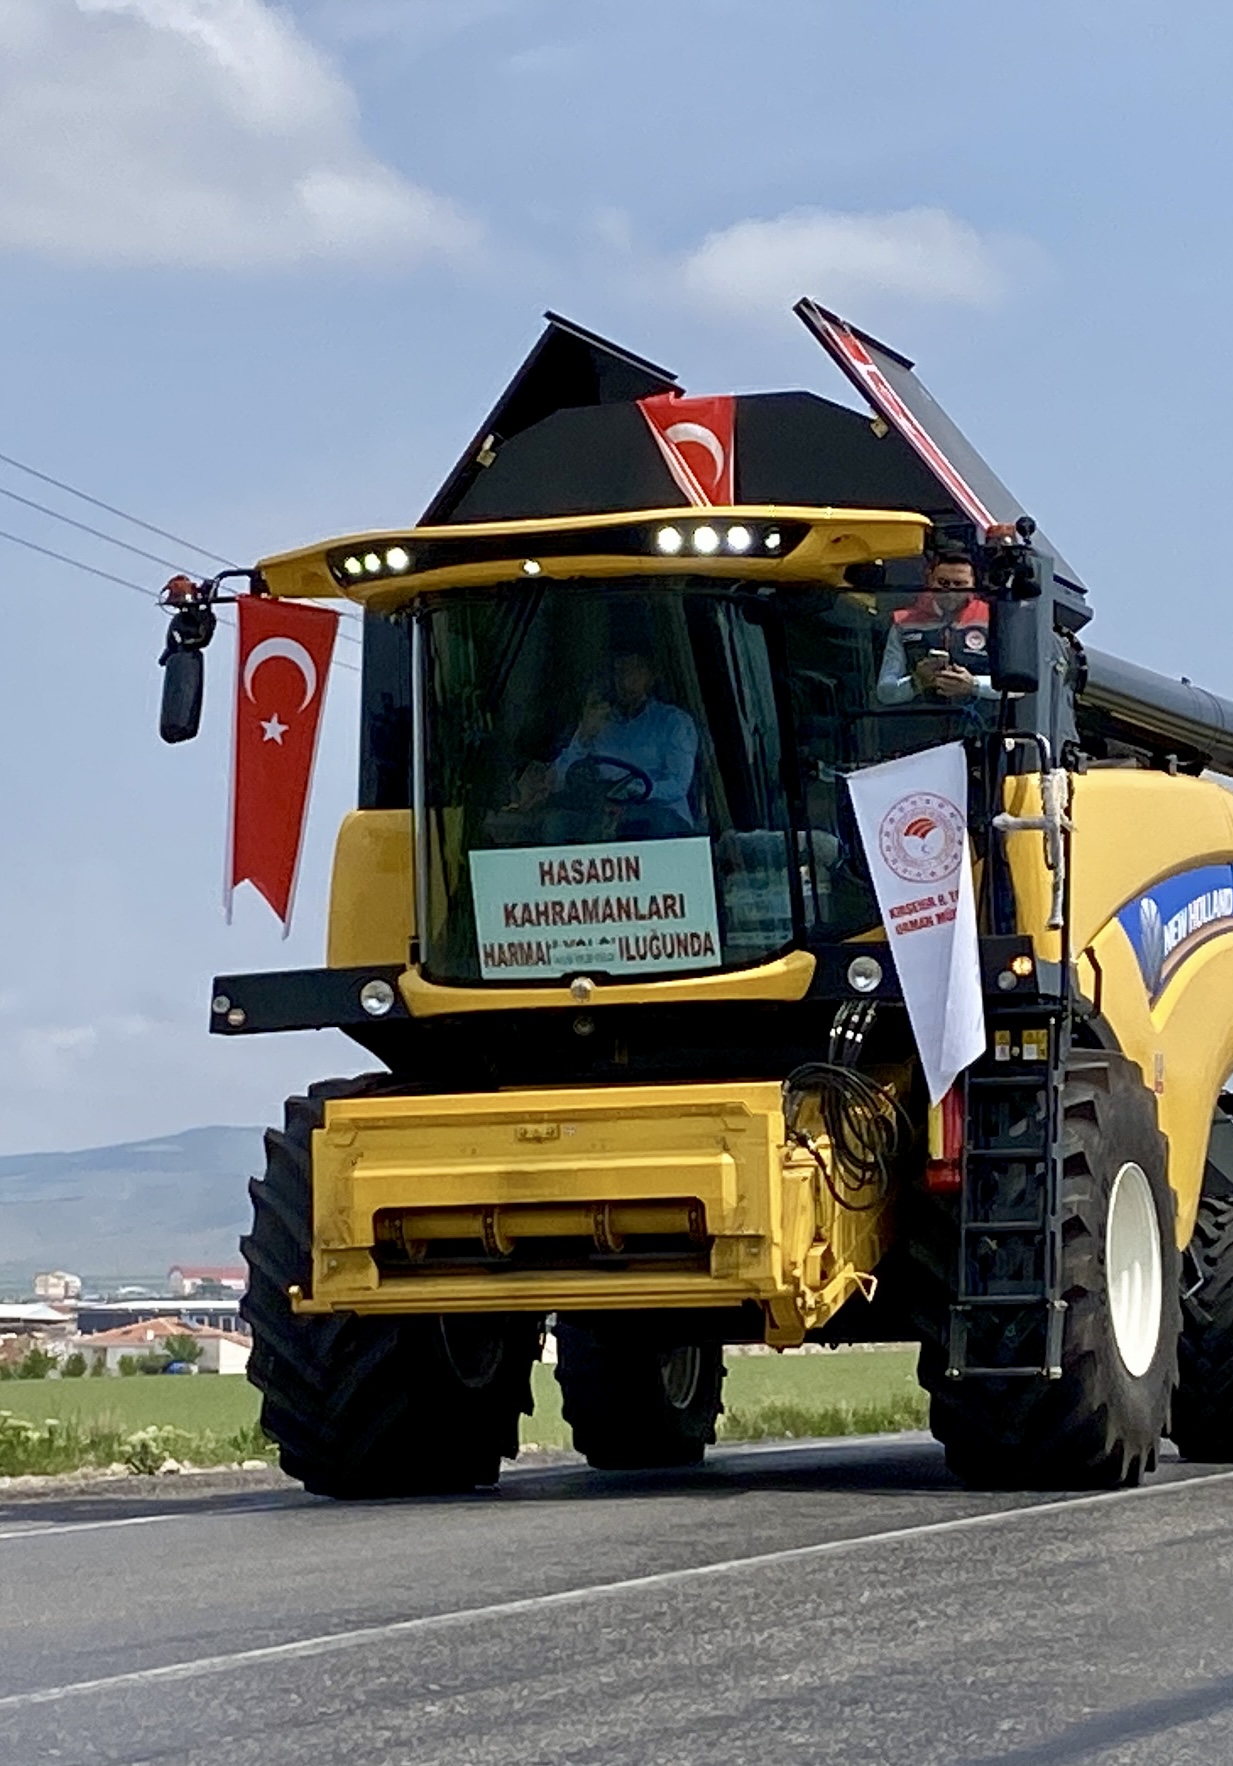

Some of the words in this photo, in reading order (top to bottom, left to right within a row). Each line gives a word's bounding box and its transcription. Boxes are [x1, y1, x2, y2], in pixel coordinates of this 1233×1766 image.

[538, 855, 641, 886] HASADIN
[503, 892, 686, 928] KAHRAMANLARI
[1163, 906, 1187, 957] NEW
[1187, 887, 1233, 934] HOLLAND
